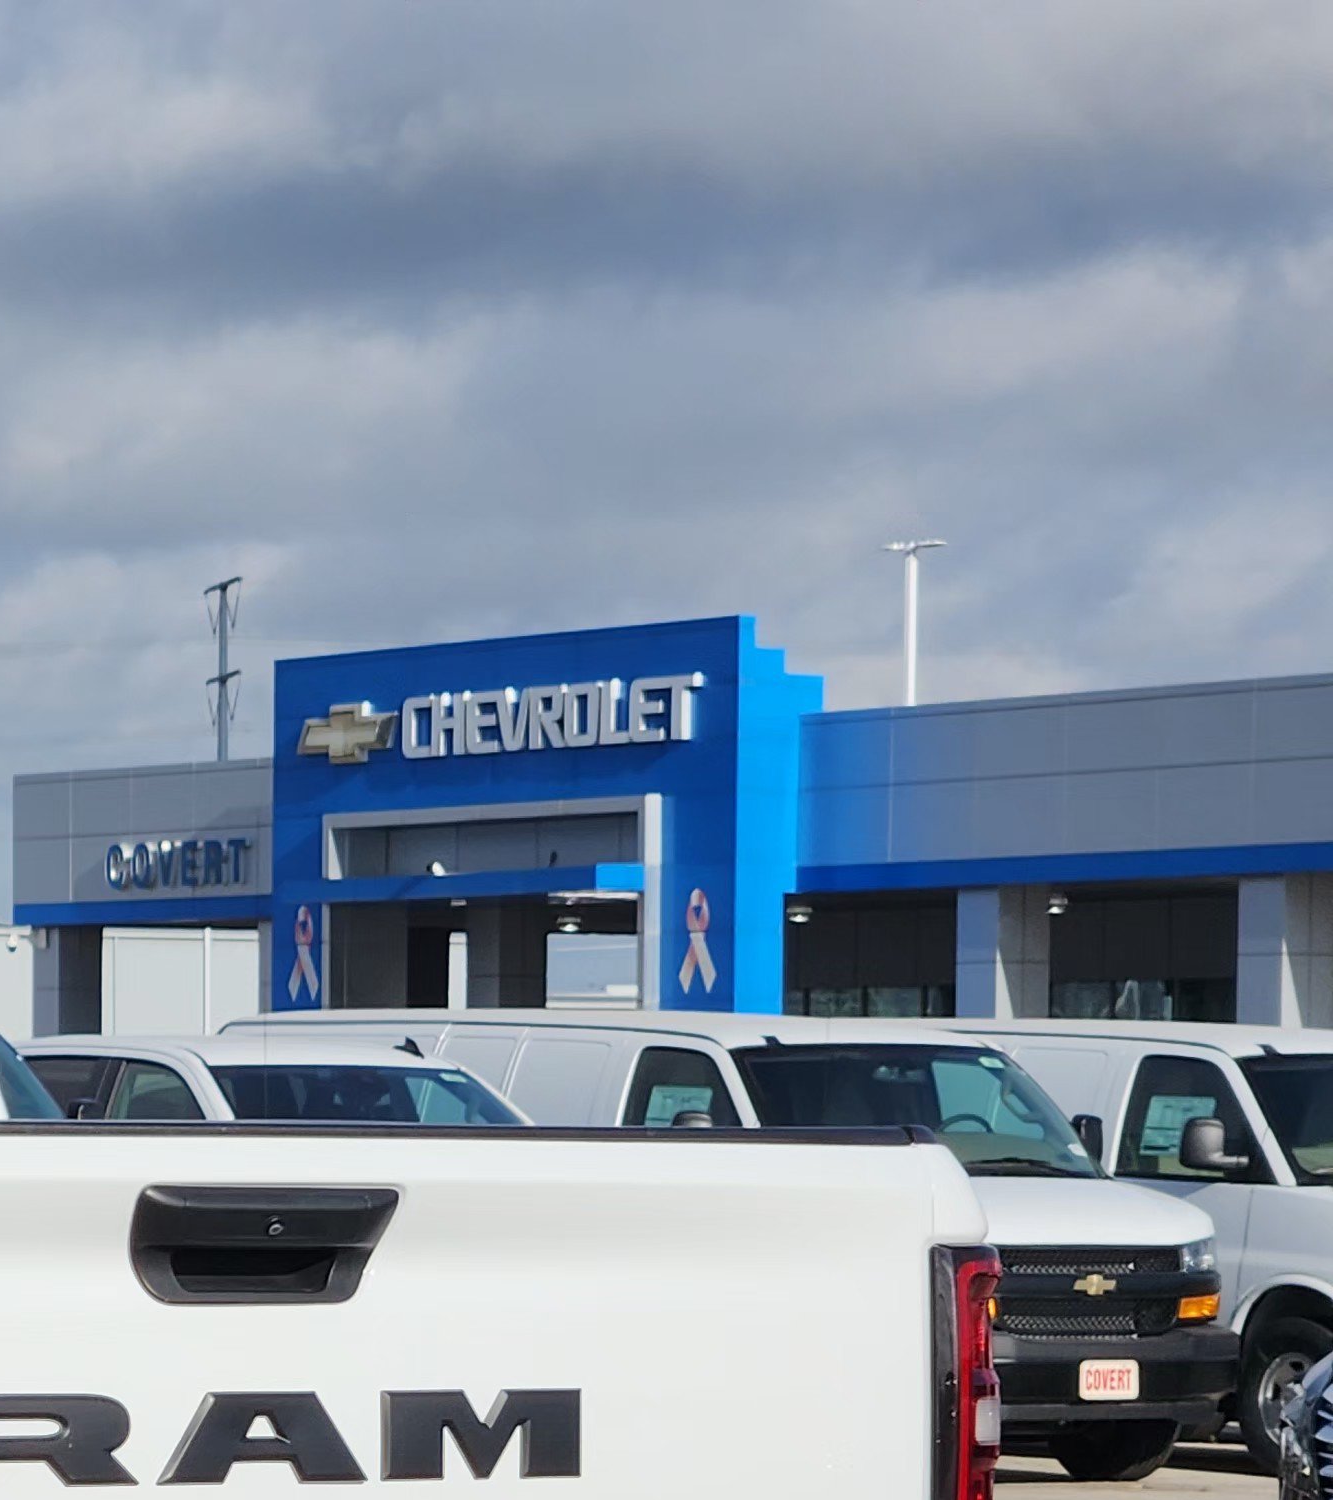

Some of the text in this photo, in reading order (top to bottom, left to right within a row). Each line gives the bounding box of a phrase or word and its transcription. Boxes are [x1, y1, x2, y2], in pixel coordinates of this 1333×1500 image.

[402, 673, 703, 759] CHEVROLET
[106, 839, 249, 889] COVERT
[1085, 1368, 1132, 1391] COVERT
